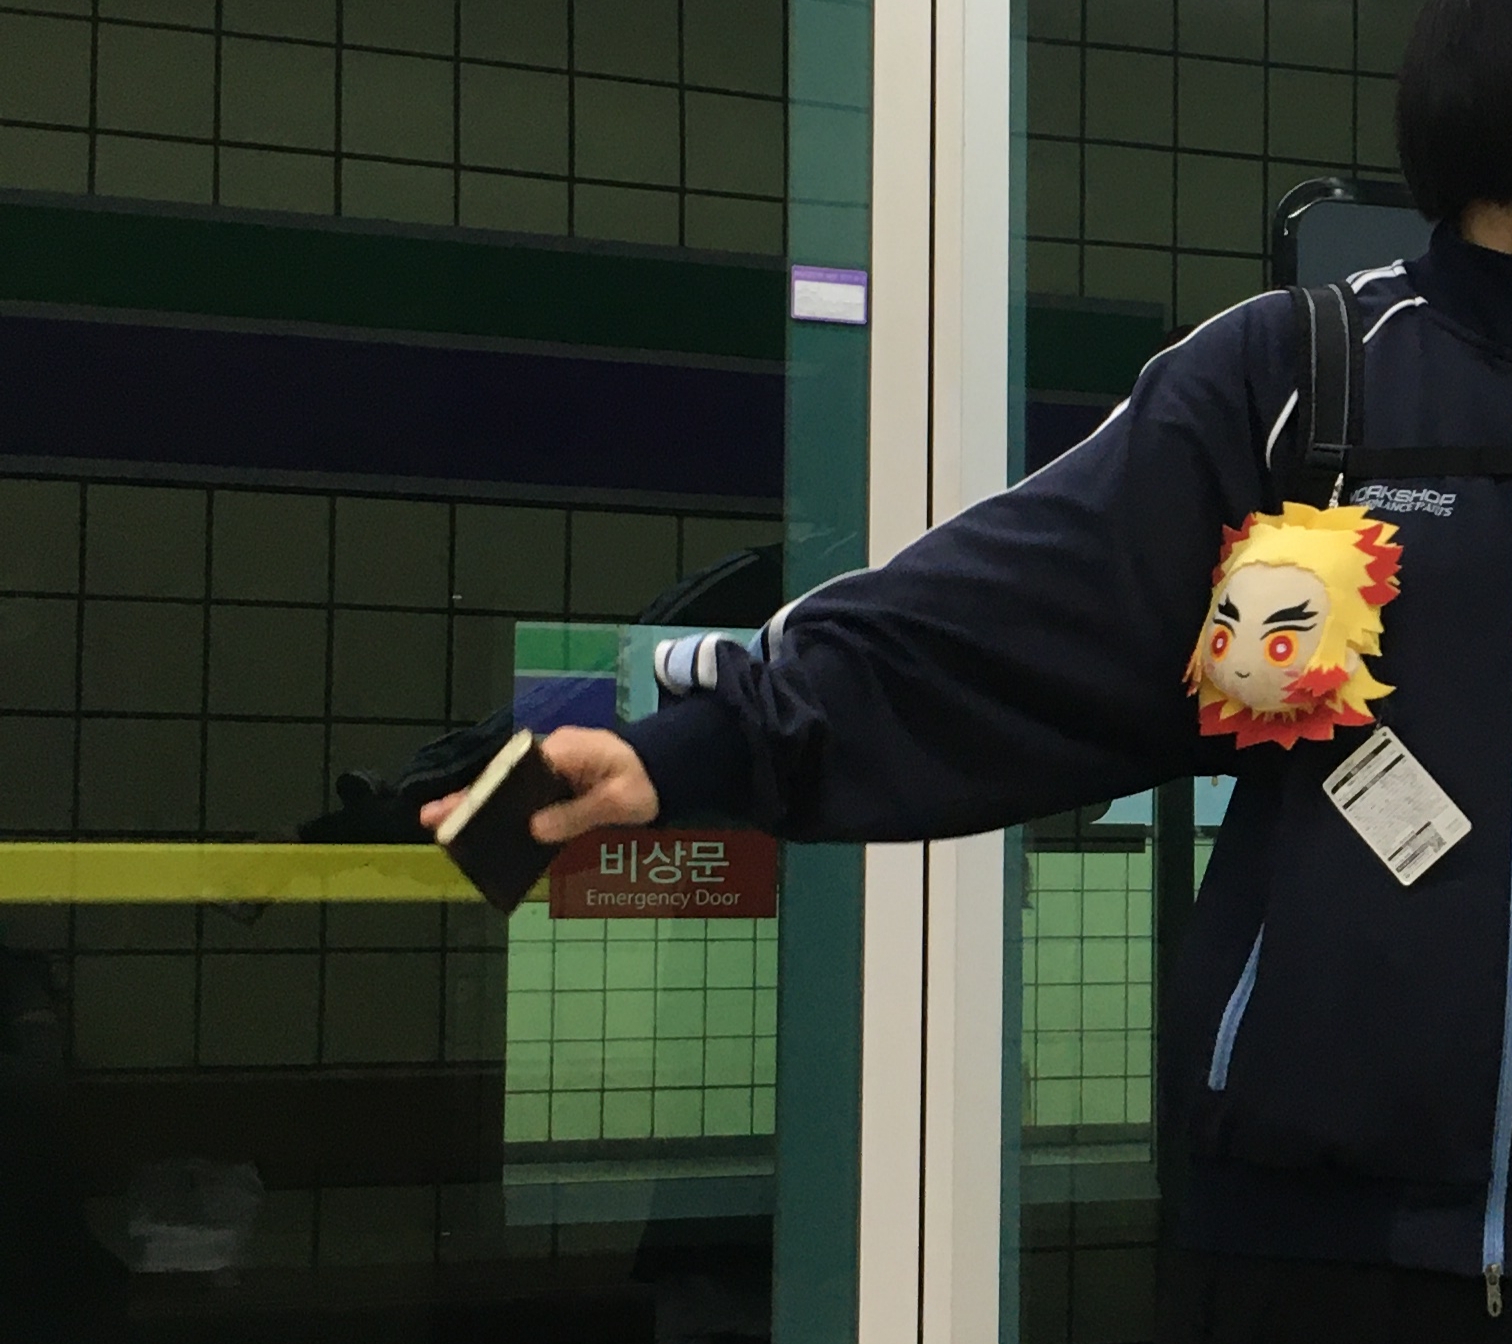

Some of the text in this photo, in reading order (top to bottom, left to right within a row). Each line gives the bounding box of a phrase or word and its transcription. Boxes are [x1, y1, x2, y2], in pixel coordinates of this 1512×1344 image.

[600, 839, 730, 884] 비상문
[586, 888, 741, 910] Emergency Door
